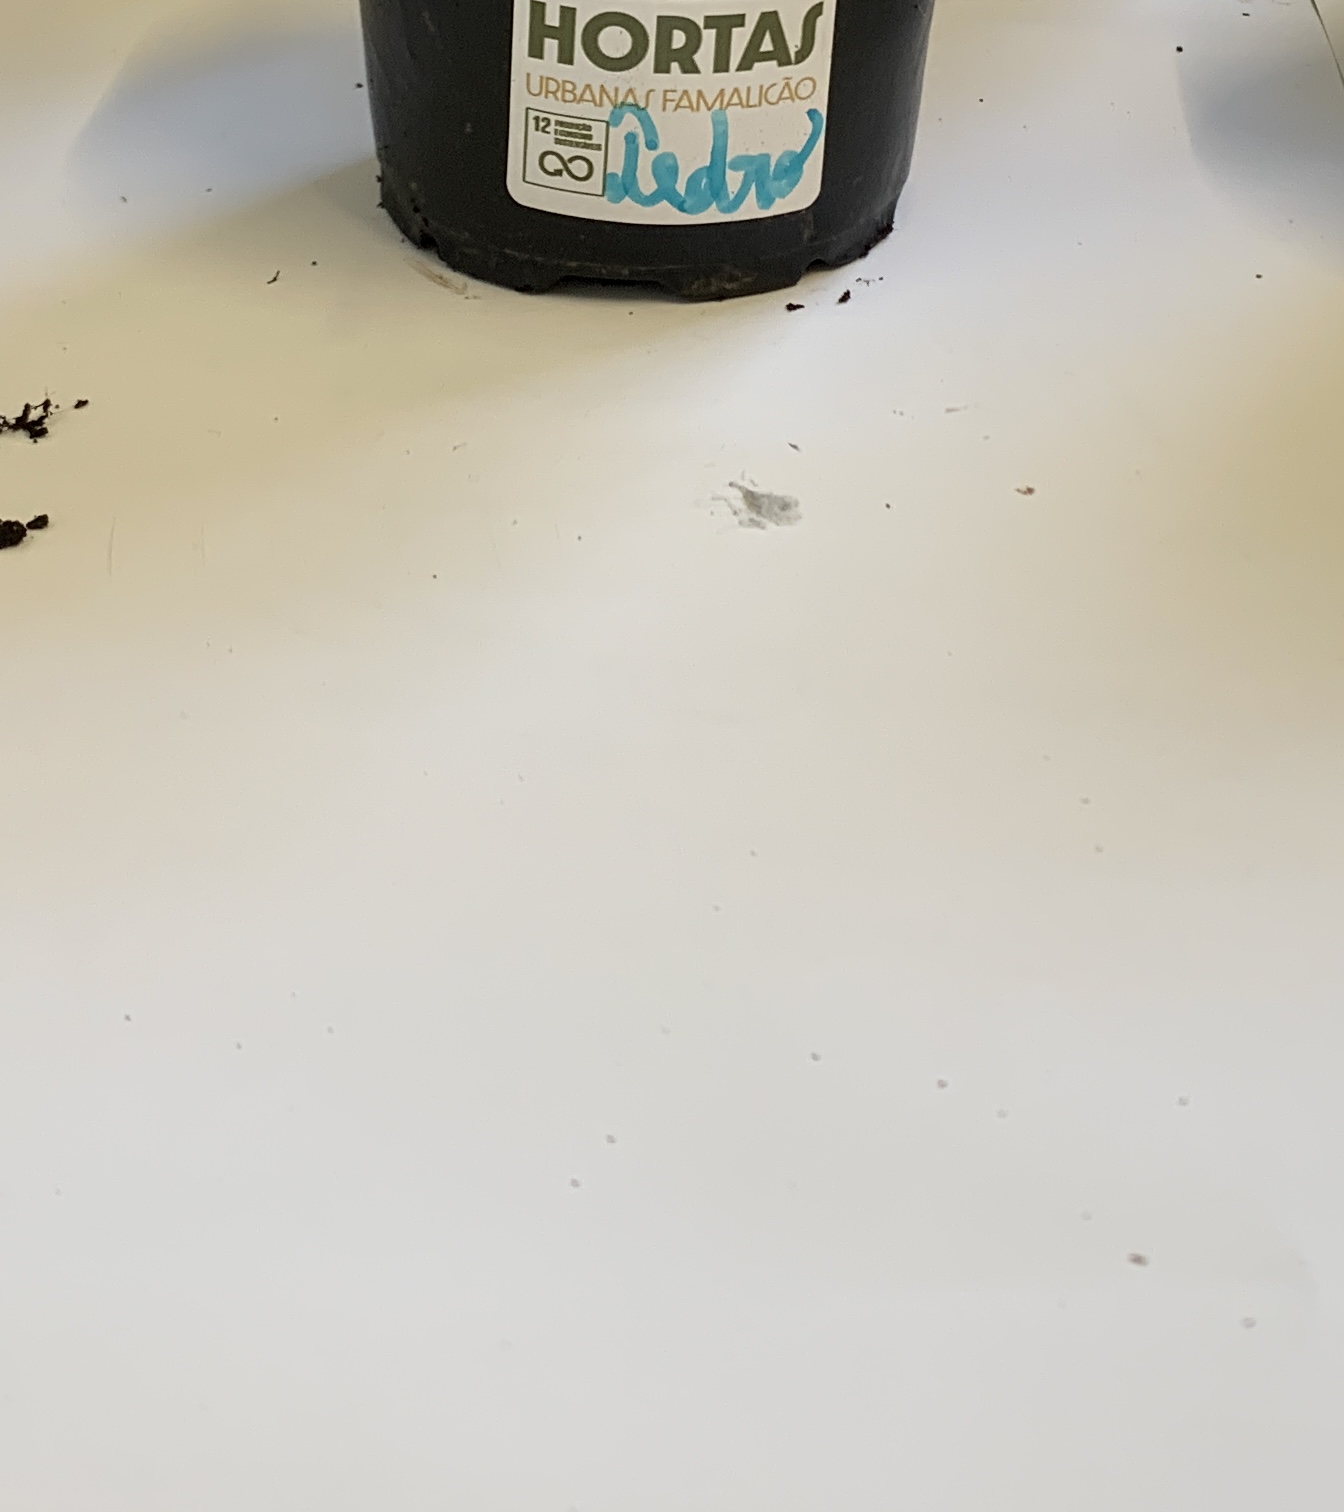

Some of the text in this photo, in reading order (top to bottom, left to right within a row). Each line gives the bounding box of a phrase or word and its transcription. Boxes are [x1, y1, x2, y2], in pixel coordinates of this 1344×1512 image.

[527, 0, 824, 75] HORTAS
[525, 72, 817, 113] URBANAS FAMALICÃO
[532, 115, 551, 135] 12
